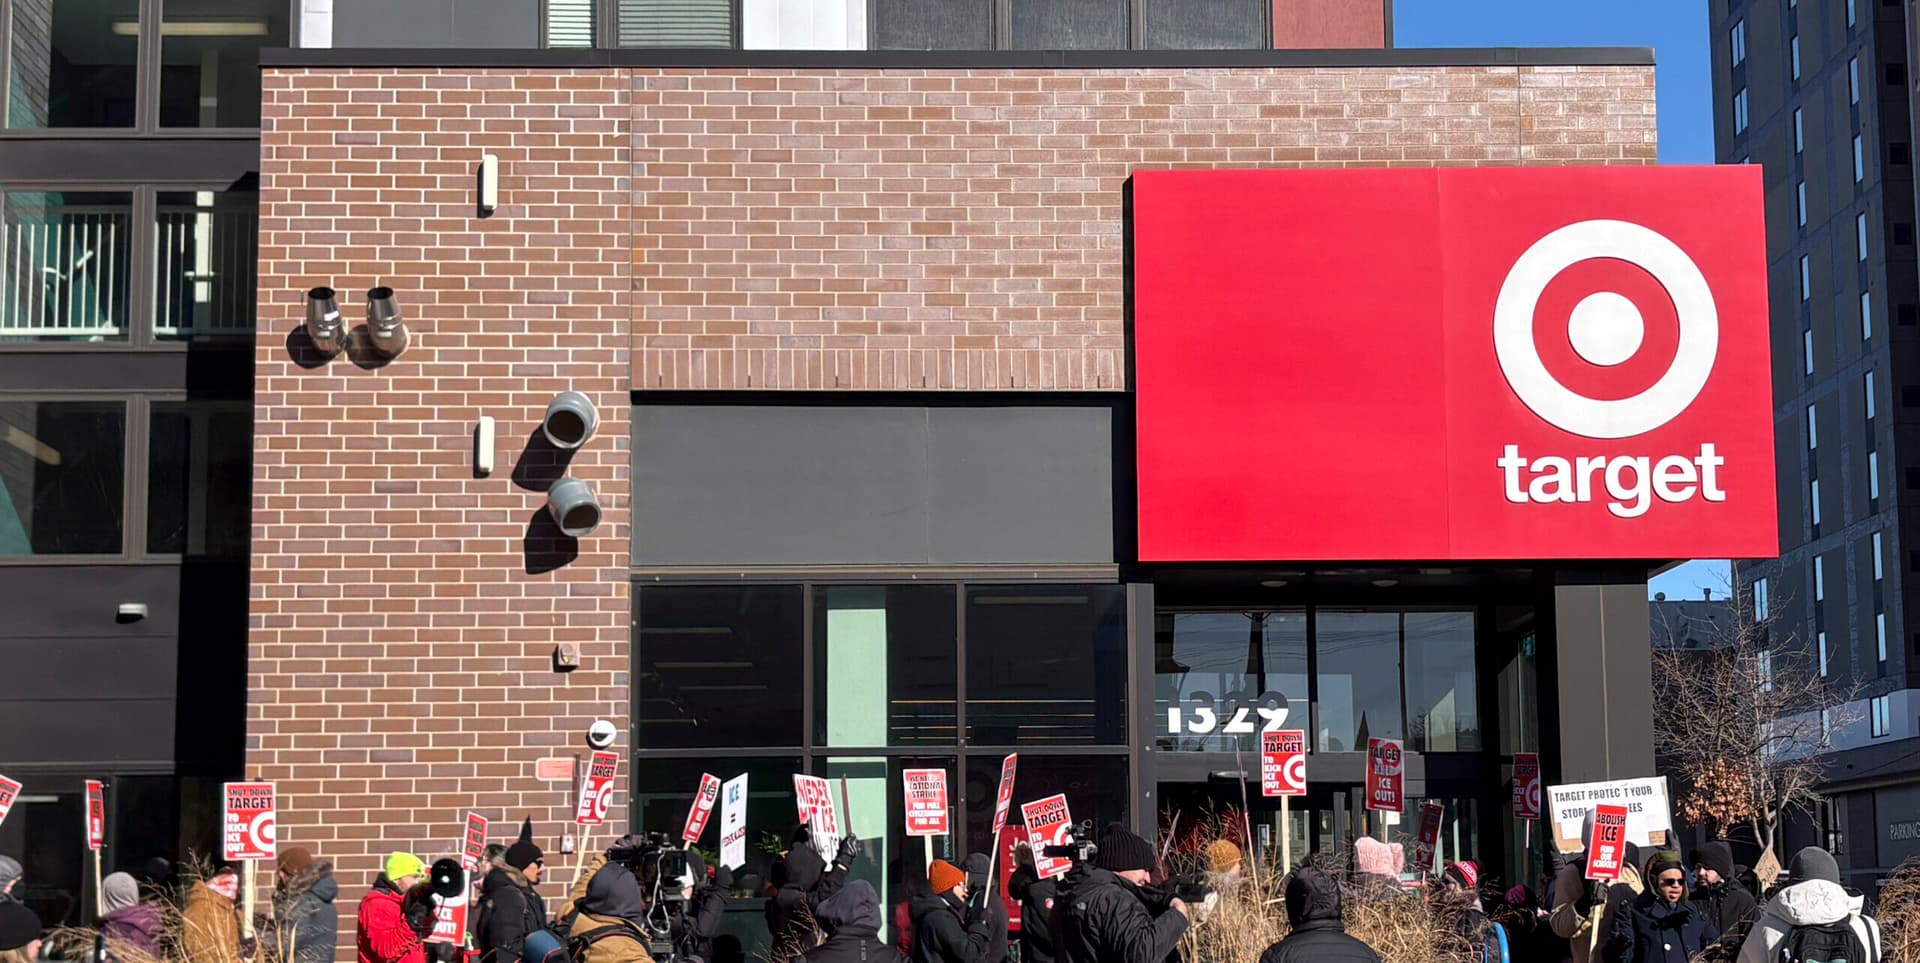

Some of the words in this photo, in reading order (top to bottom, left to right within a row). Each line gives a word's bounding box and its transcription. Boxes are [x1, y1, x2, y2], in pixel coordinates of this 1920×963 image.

[1497, 443, 1726, 518] target
[1168, 691, 1289, 733] 1329
[1264, 743, 1302, 752] TARGET
[1369, 747, 1401, 761] TARGET
[1265, 781, 1280, 789] OUT
[1378, 777, 1391, 789] ICE
[1375, 790, 1395, 802] OUT!
[1554, 791, 1586, 803] TARGET
[1631, 785, 1653, 797] YOUR
[228, 798, 272, 809] TARGET
[1025, 807, 1042, 817] SHUT
[1028, 809, 1067, 828] TARGET
[1596, 814, 1626, 825] ABOLISH
[1032, 832, 1042, 841] TO
[1601, 826, 1618, 841] ICE
[228, 843, 245, 852] OUT
